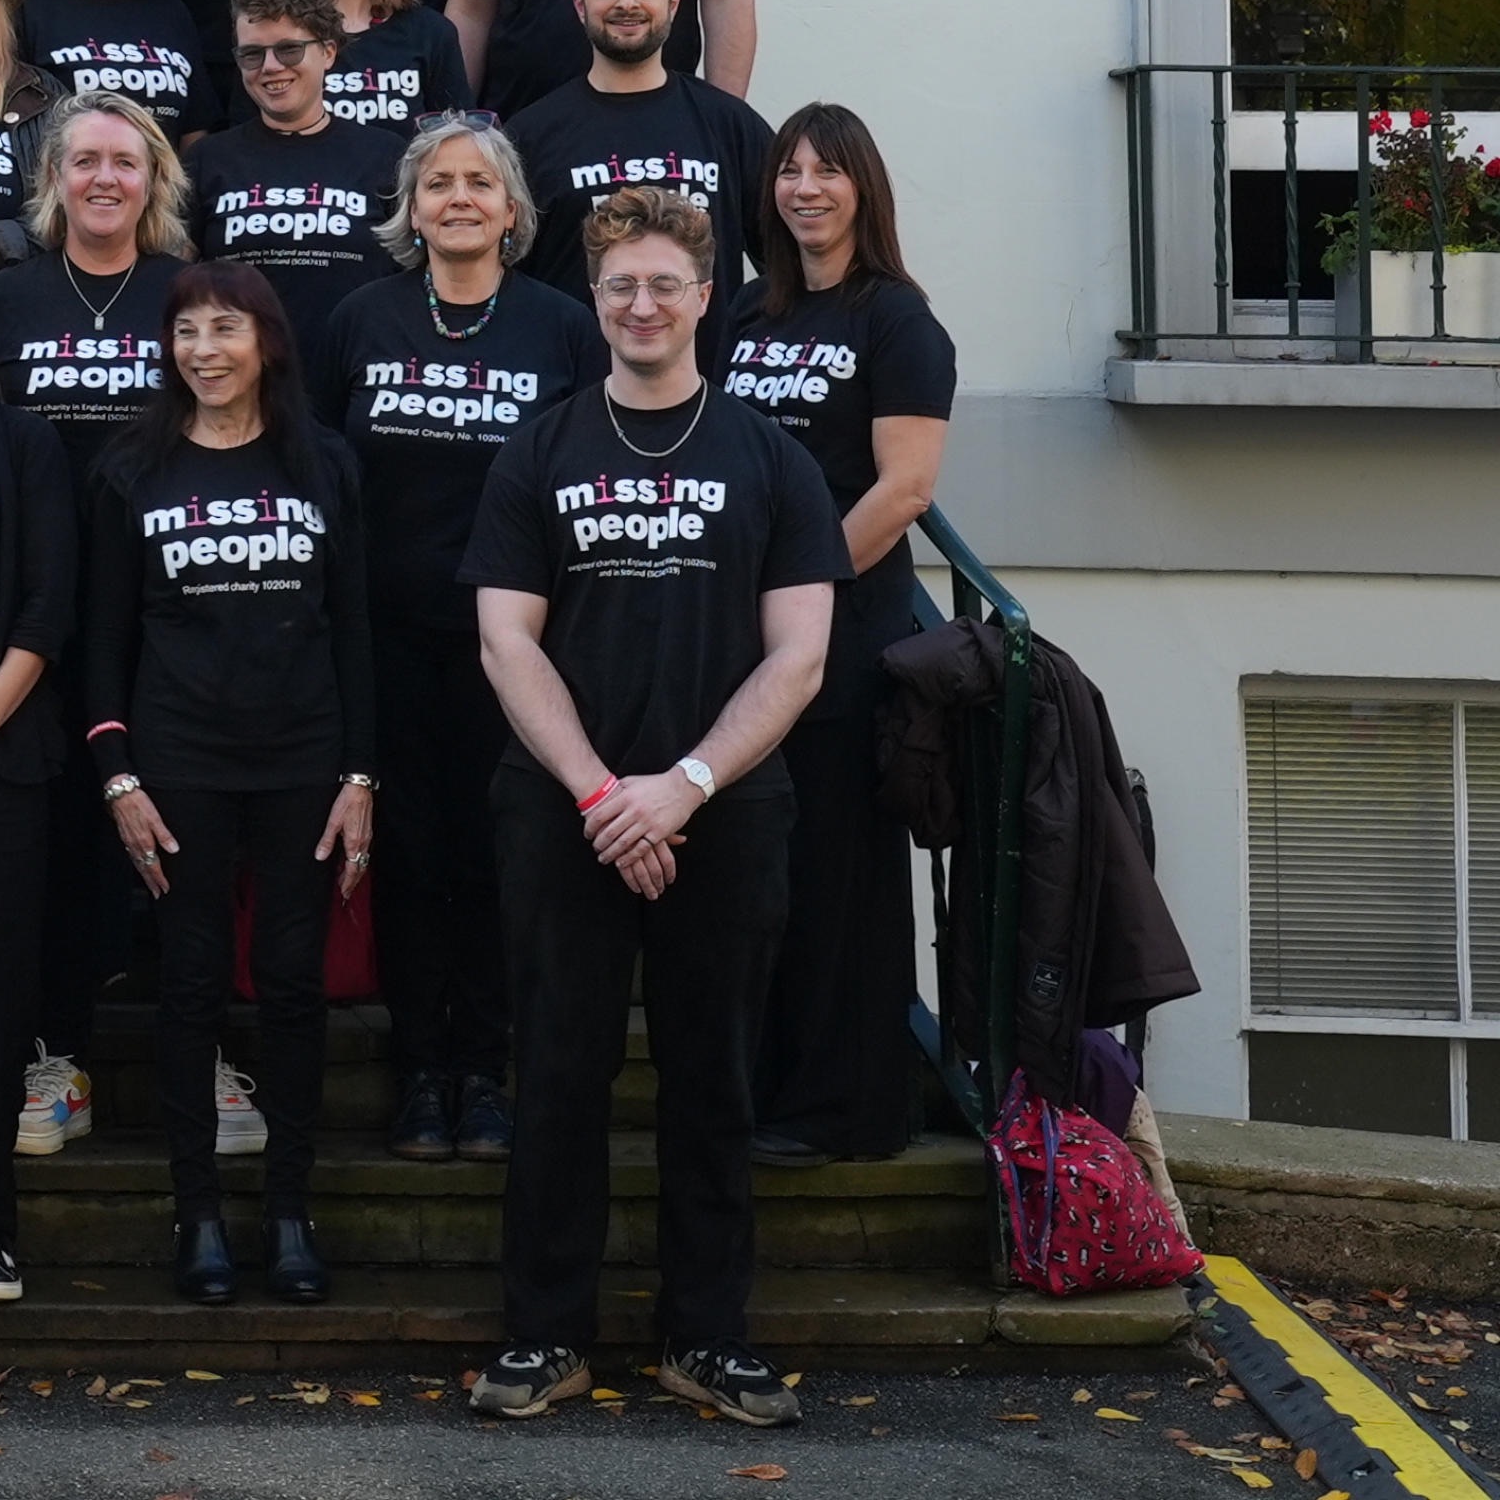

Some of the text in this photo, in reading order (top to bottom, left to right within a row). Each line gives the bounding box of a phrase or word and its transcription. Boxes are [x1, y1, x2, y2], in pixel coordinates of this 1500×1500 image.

[50, 37, 193, 79] missing
[73, 65, 188, 98] people
[325, 68, 420, 97] ssing
[322, 93, 409, 125] ople
[570, 151, 719, 192] missing
[215, 183, 367, 216] missing
[224, 208, 351, 245] people
[270, 249, 297, 257] England
[311, 250, 332, 258] Wales
[19, 333, 163, 360] missin
[26, 360, 164, 396] people
[365, 356, 538, 402] missing
[43, 404, 71, 412] charity
[72, 403, 80, 411] in
[81, 403, 113, 412] England
[72, 412, 106, 420] Scotland
[369, 389, 520, 427] people
[371, 423, 510, 443] Registered Charity No. 10204
[555, 472, 726, 515] missing
[143, 489, 326, 537] missing
[573, 506, 705, 551] people
[162, 525, 314, 579] people
[182, 579, 302, 596] Registered charity 1020419
